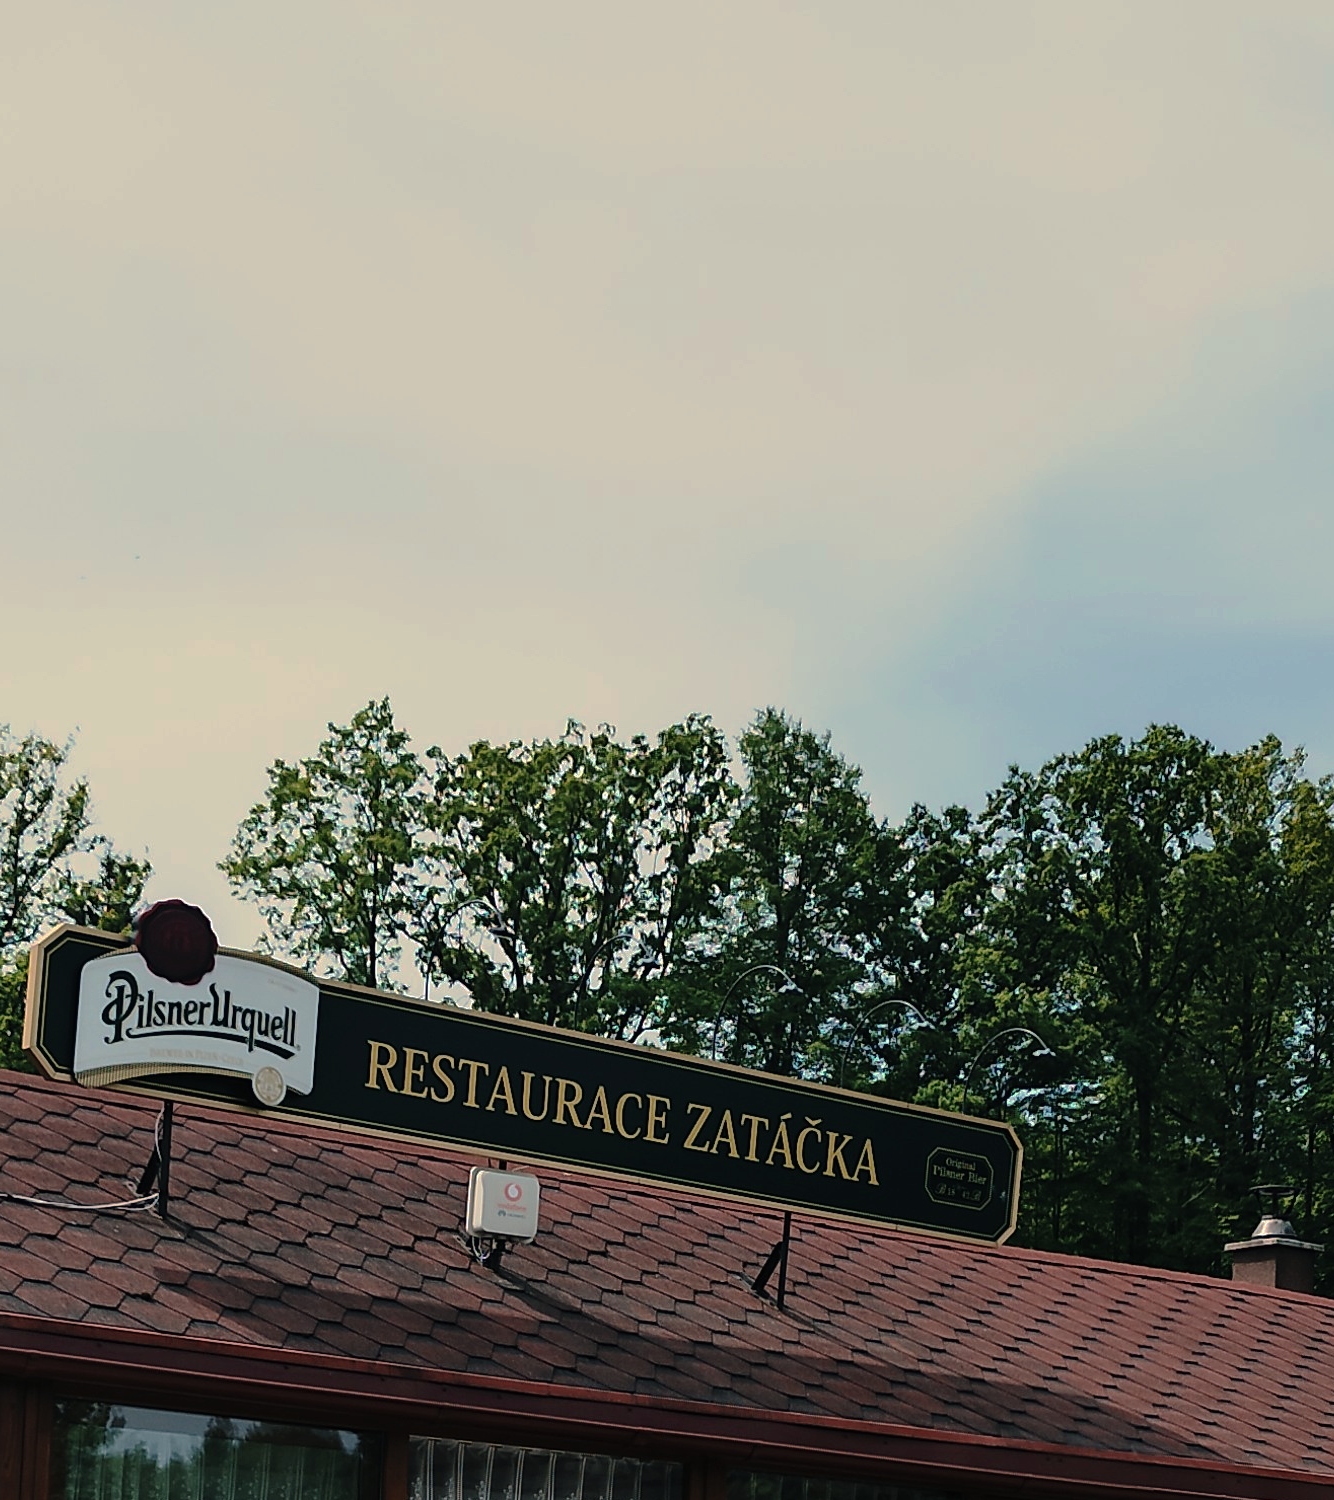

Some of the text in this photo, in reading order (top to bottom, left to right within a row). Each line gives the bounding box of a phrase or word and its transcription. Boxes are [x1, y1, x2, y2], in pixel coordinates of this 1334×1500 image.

[102, 970, 298, 1053] Pilsner Urquell
[364, 1040, 880, 1187] RESTAURACE ZATÁČKA
[932, 1164, 988, 1185] Pilsner Bier
[945, 1157, 976, 1171] Original
